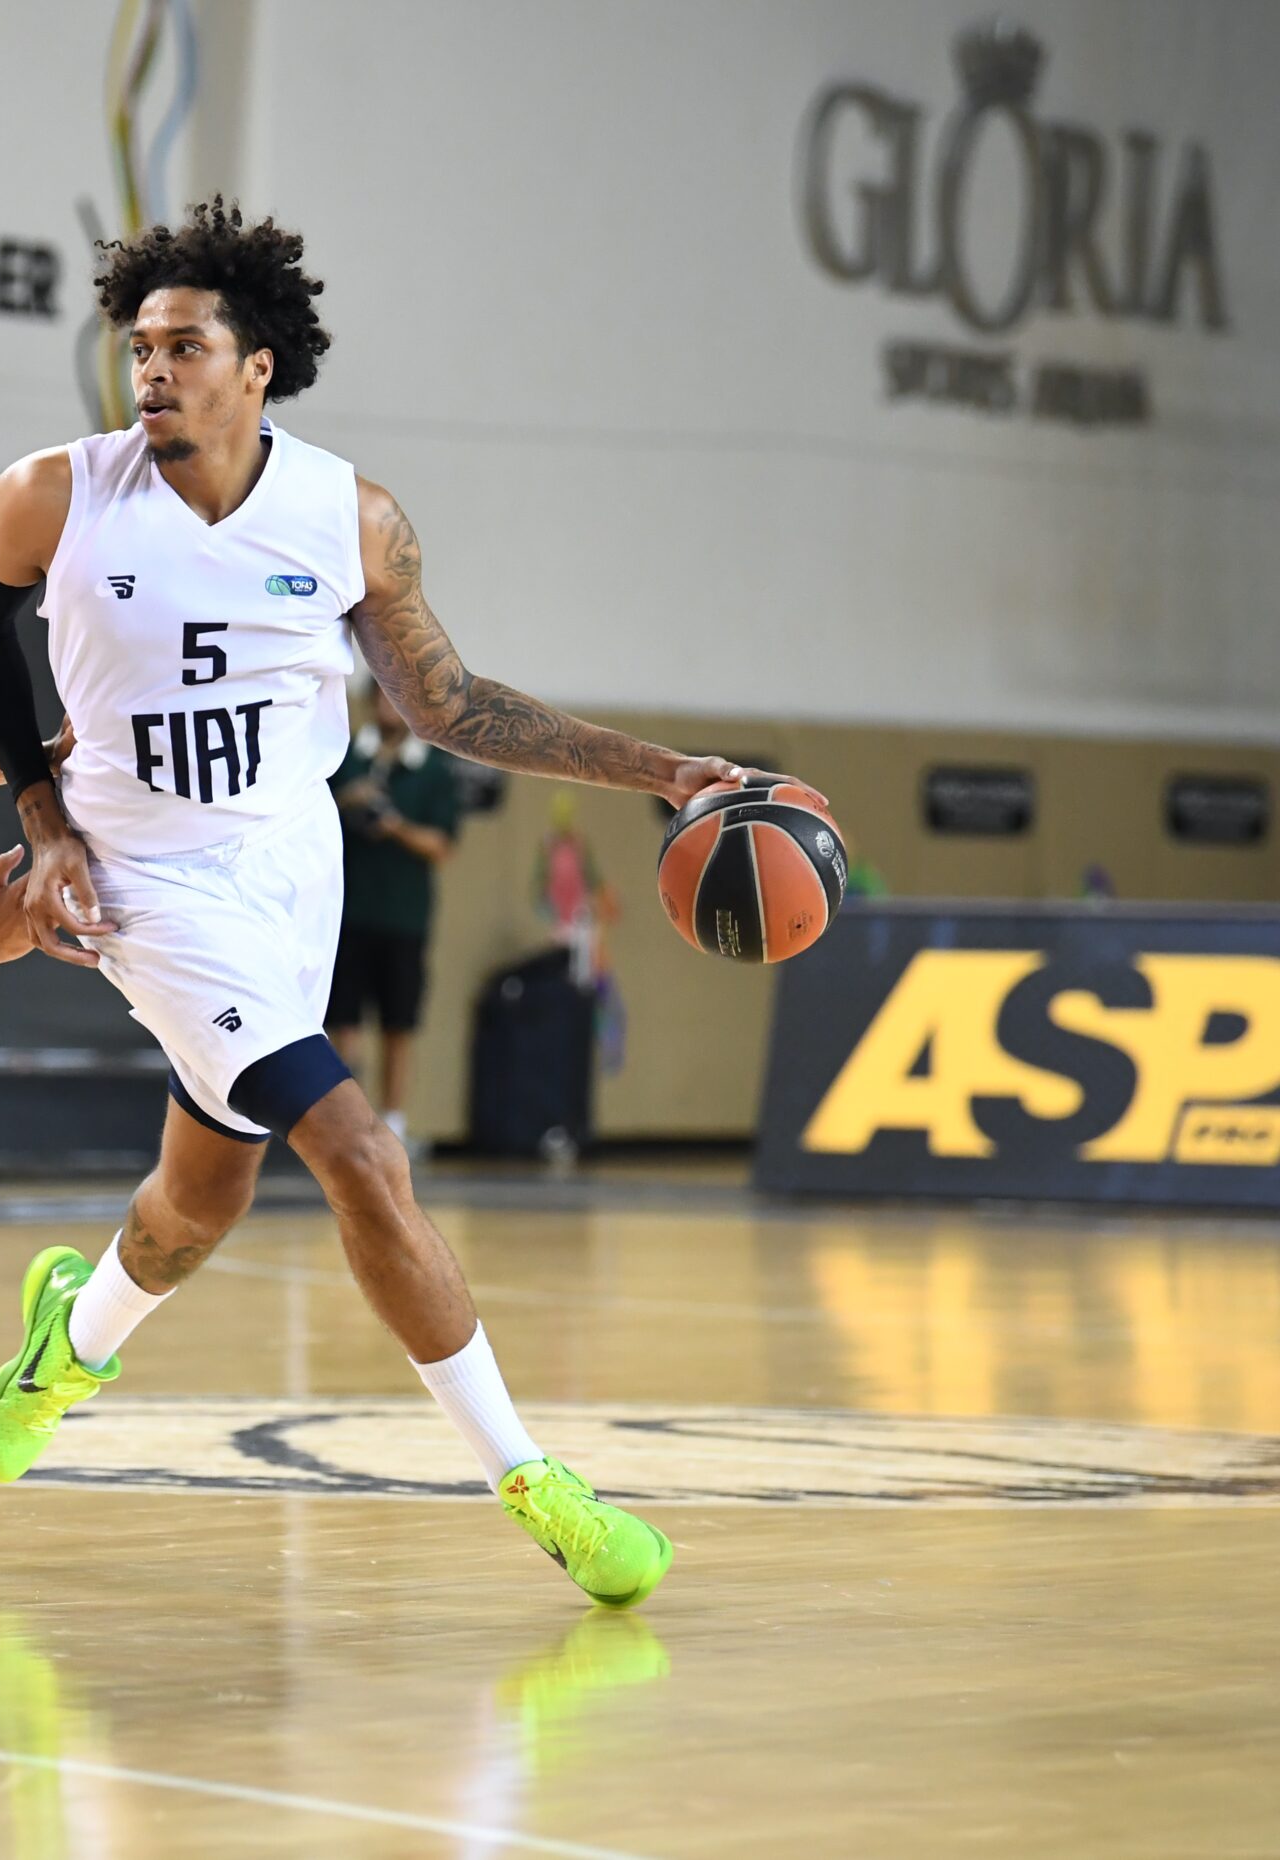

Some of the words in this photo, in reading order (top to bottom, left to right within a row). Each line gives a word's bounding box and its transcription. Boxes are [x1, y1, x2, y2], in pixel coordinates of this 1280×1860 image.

[794, 76, 1229, 335] GLORIA
[182, 622, 228, 686] 5
[131, 699, 273, 804] FIAT
